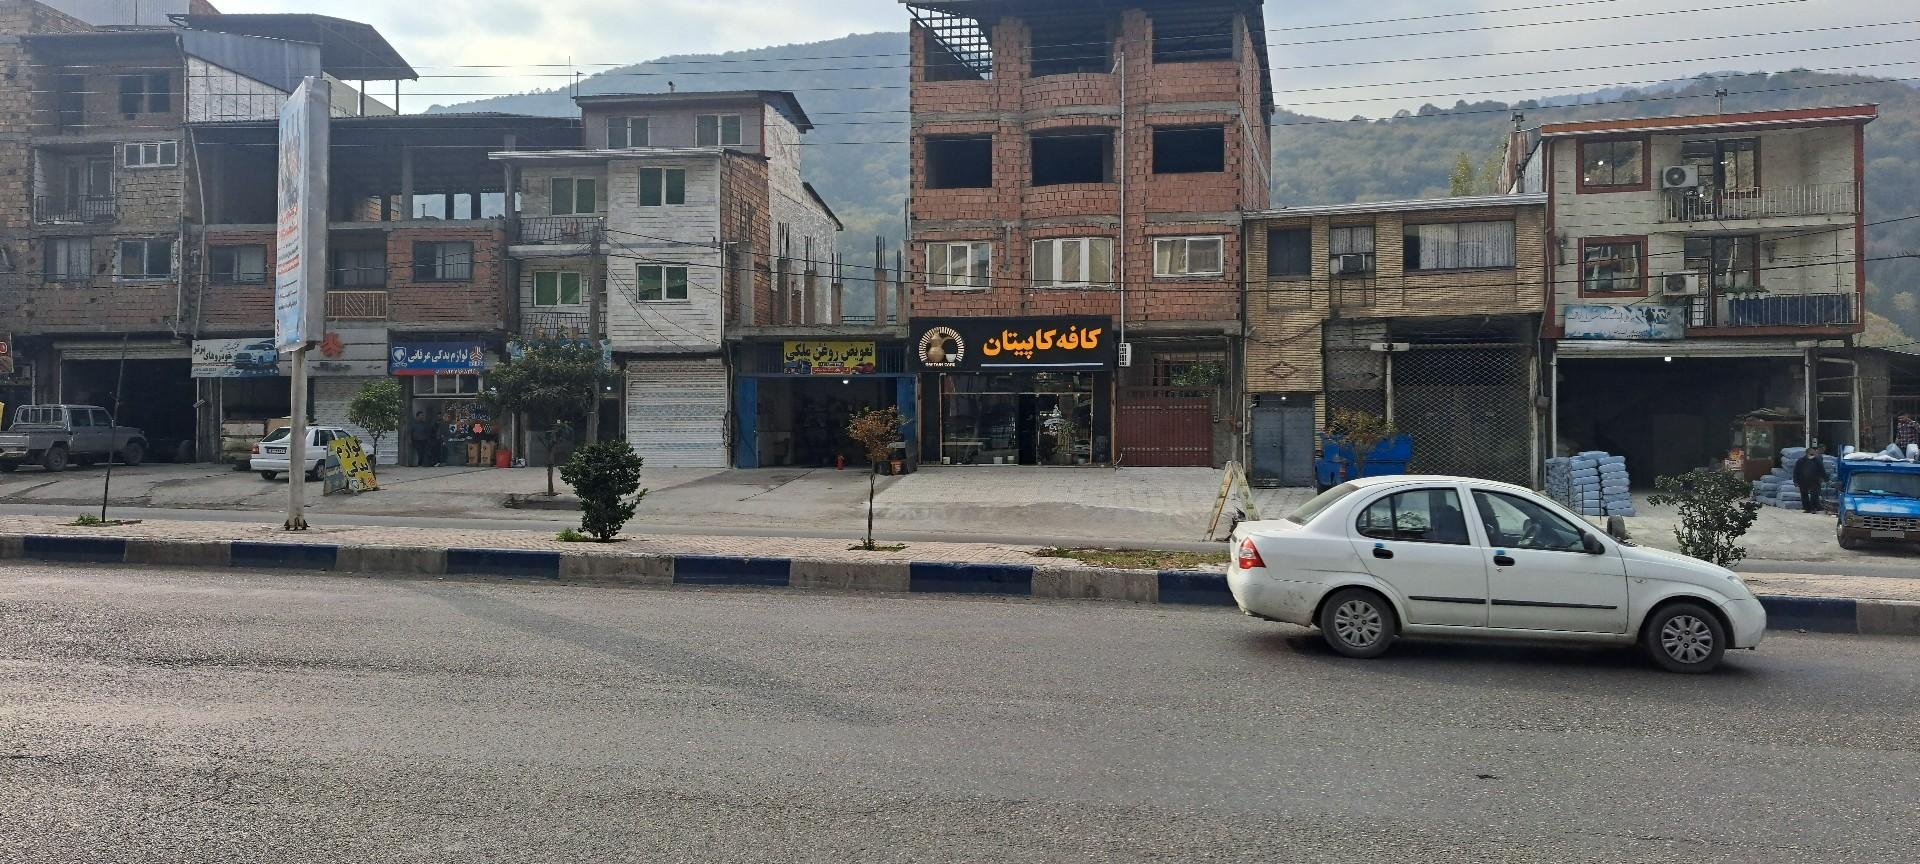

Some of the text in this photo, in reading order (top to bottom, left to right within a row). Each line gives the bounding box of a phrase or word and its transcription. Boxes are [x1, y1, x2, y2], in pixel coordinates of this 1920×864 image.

[983, 325, 1102, 359] کافه کاپیتان
[203, 351, 233, 362] خودروهای
[431, 348, 450, 363] یدکی
[450, 348, 468, 362] لوازم
[813, 343, 839, 361] روغن
[841, 343, 873, 361] تعویض
[336, 438, 361, 459] لوازم
[347, 460, 371, 478] یدکی
